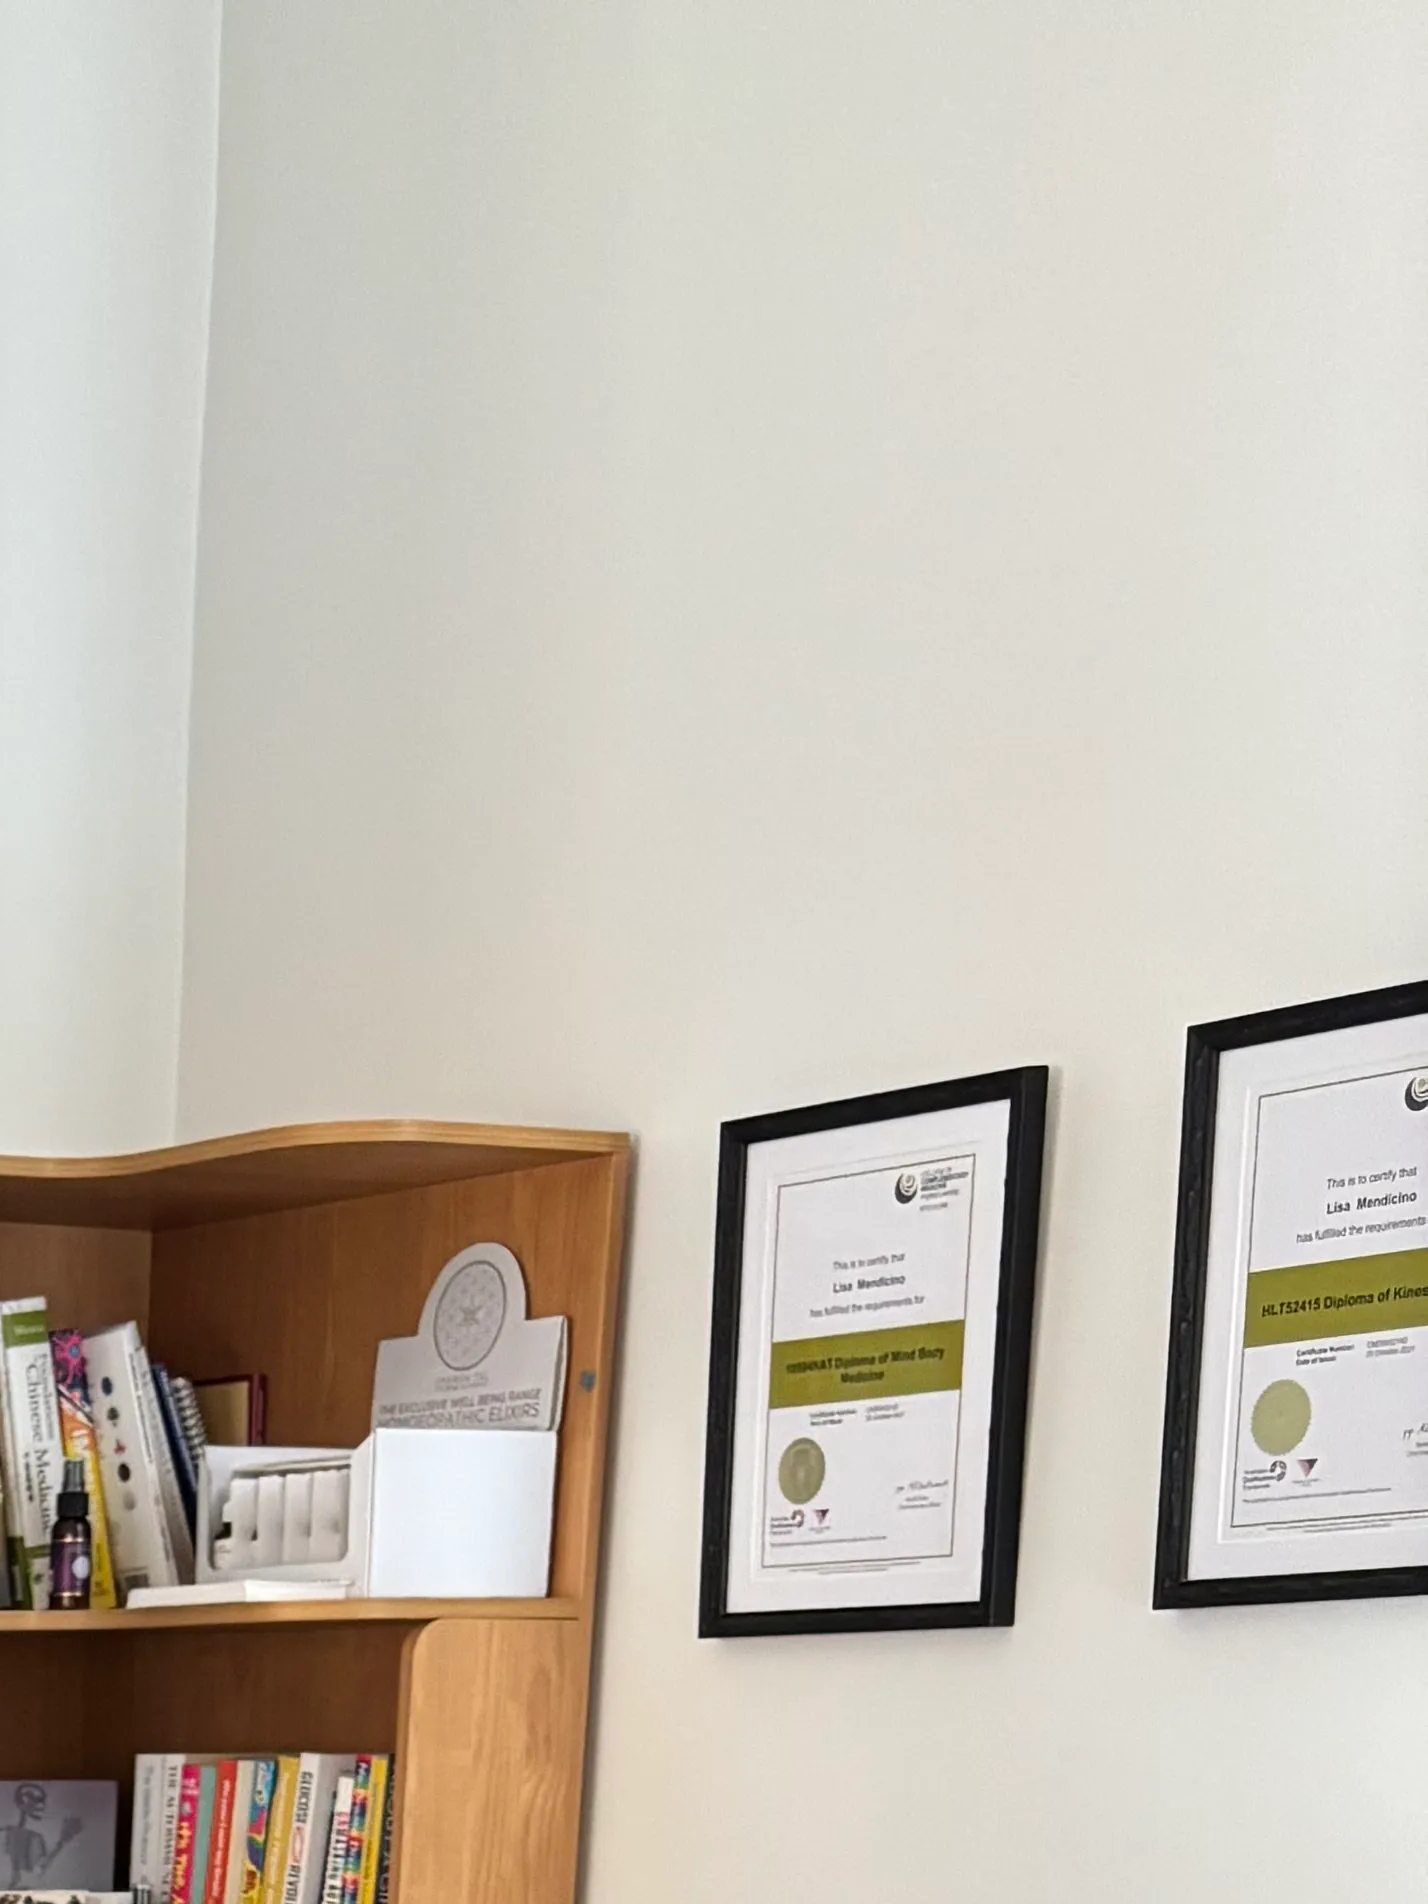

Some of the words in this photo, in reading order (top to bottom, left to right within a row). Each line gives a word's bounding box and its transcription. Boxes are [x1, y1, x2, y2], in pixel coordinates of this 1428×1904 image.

[1327, 1179, 1345, 1190] This
[1347, 1177, 1356, 1186] is
[1399, 1166, 1417, 1178] that
[1326, 1202, 1350, 1215] Lisa
[1356, 1192, 1417, 1210] Mendicino
[1261, 1297, 1320, 1317] HLT52415
[1323, 1293, 1373, 1310] Diploma
[1377, 1288, 1390, 1302] of
[26, 1363, 42, 1442] Chinese
